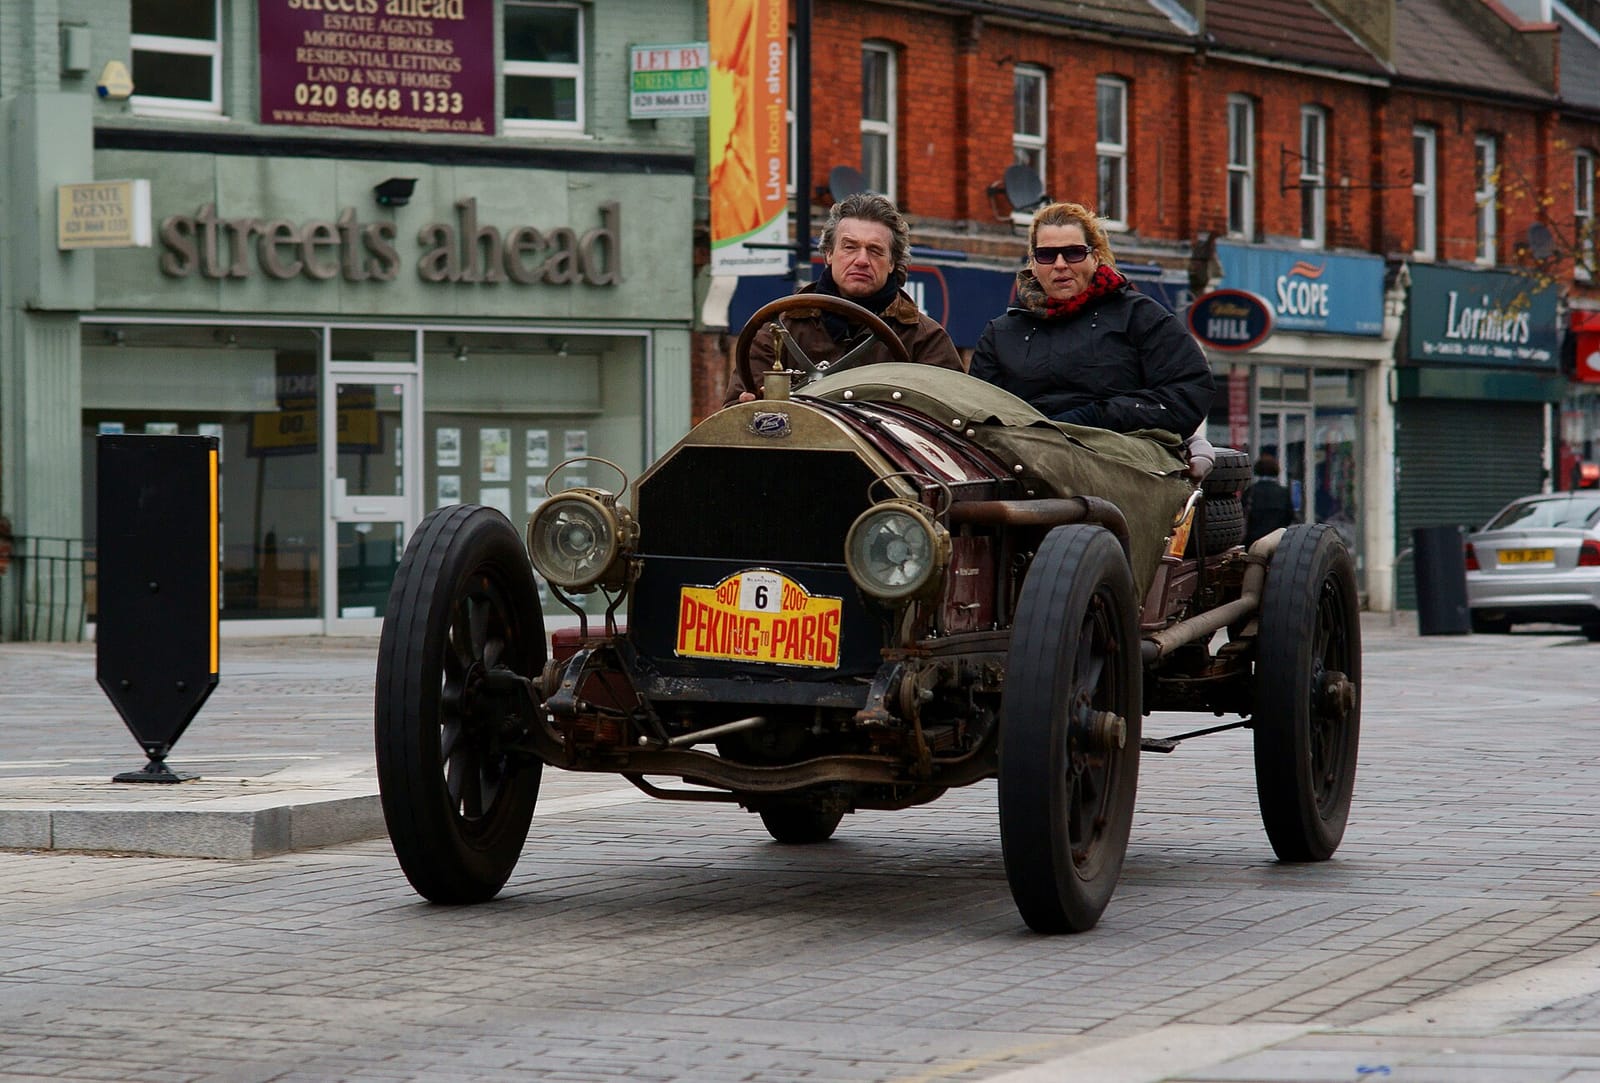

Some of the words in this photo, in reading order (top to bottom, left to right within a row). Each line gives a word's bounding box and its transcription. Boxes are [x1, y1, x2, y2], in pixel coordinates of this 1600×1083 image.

[324, 14, 375, 31] ESTATE
[378, 18, 434, 35] AGENTS
[304, 31, 385, 51] MORTGAGE
[388, 36, 454, 54] BROKERS
[296, 48, 391, 68] RESIDENTIAL
[394, 55, 462, 73] LETTINGS
[635, 50, 670, 71] LET
[680, 48, 702, 68] BY
[766, 41, 784, 95] shop
[307, 66, 349, 82] LAND
[351, 69, 364, 84] &
[366, 70, 400, 86] NEW
[402, 72, 452, 89] HOMES
[294, 84, 338, 107] 020
[346, 88, 401, 110] 8668
[410, 91, 464, 114] 1333
[634, 95, 653, 107] 020
[766, 157, 781, 201] Live
[72, 187, 120, 202] ESTATE
[72, 203, 125, 218] AGENTS
[159, 202, 400, 281] streets
[417, 197, 625, 287] ahead
[1277, 275, 1329, 317] SCOPE
[1207, 318, 1250, 339] HILL
[716, 579, 740, 607] 1907
[754, 585, 769, 610] 6
[782, 583, 808, 611] 2007
[679, 595, 761, 656] PEKING
[760, 630, 770, 647] TO
[769, 608, 840, 664] PARIS
